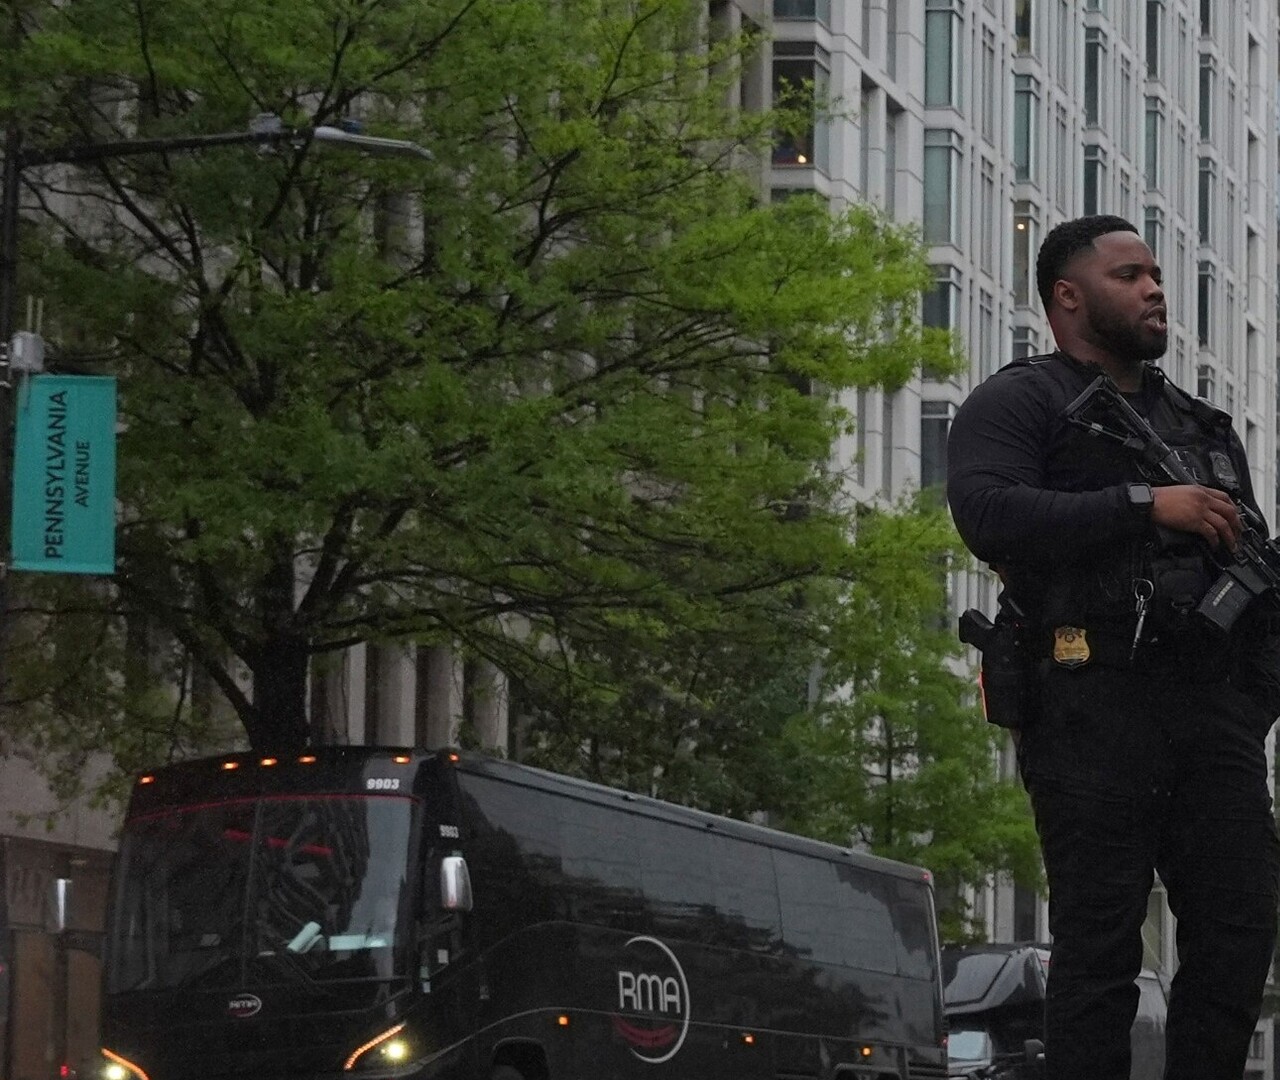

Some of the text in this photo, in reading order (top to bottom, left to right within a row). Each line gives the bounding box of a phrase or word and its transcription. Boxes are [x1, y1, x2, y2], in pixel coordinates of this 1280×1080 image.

[44, 390, 68, 560] PENNSYLVANIA
[74, 440, 90, 508] AVENUE
[366, 778, 400, 790] 9903
[618, 970, 681, 1014] RMA
